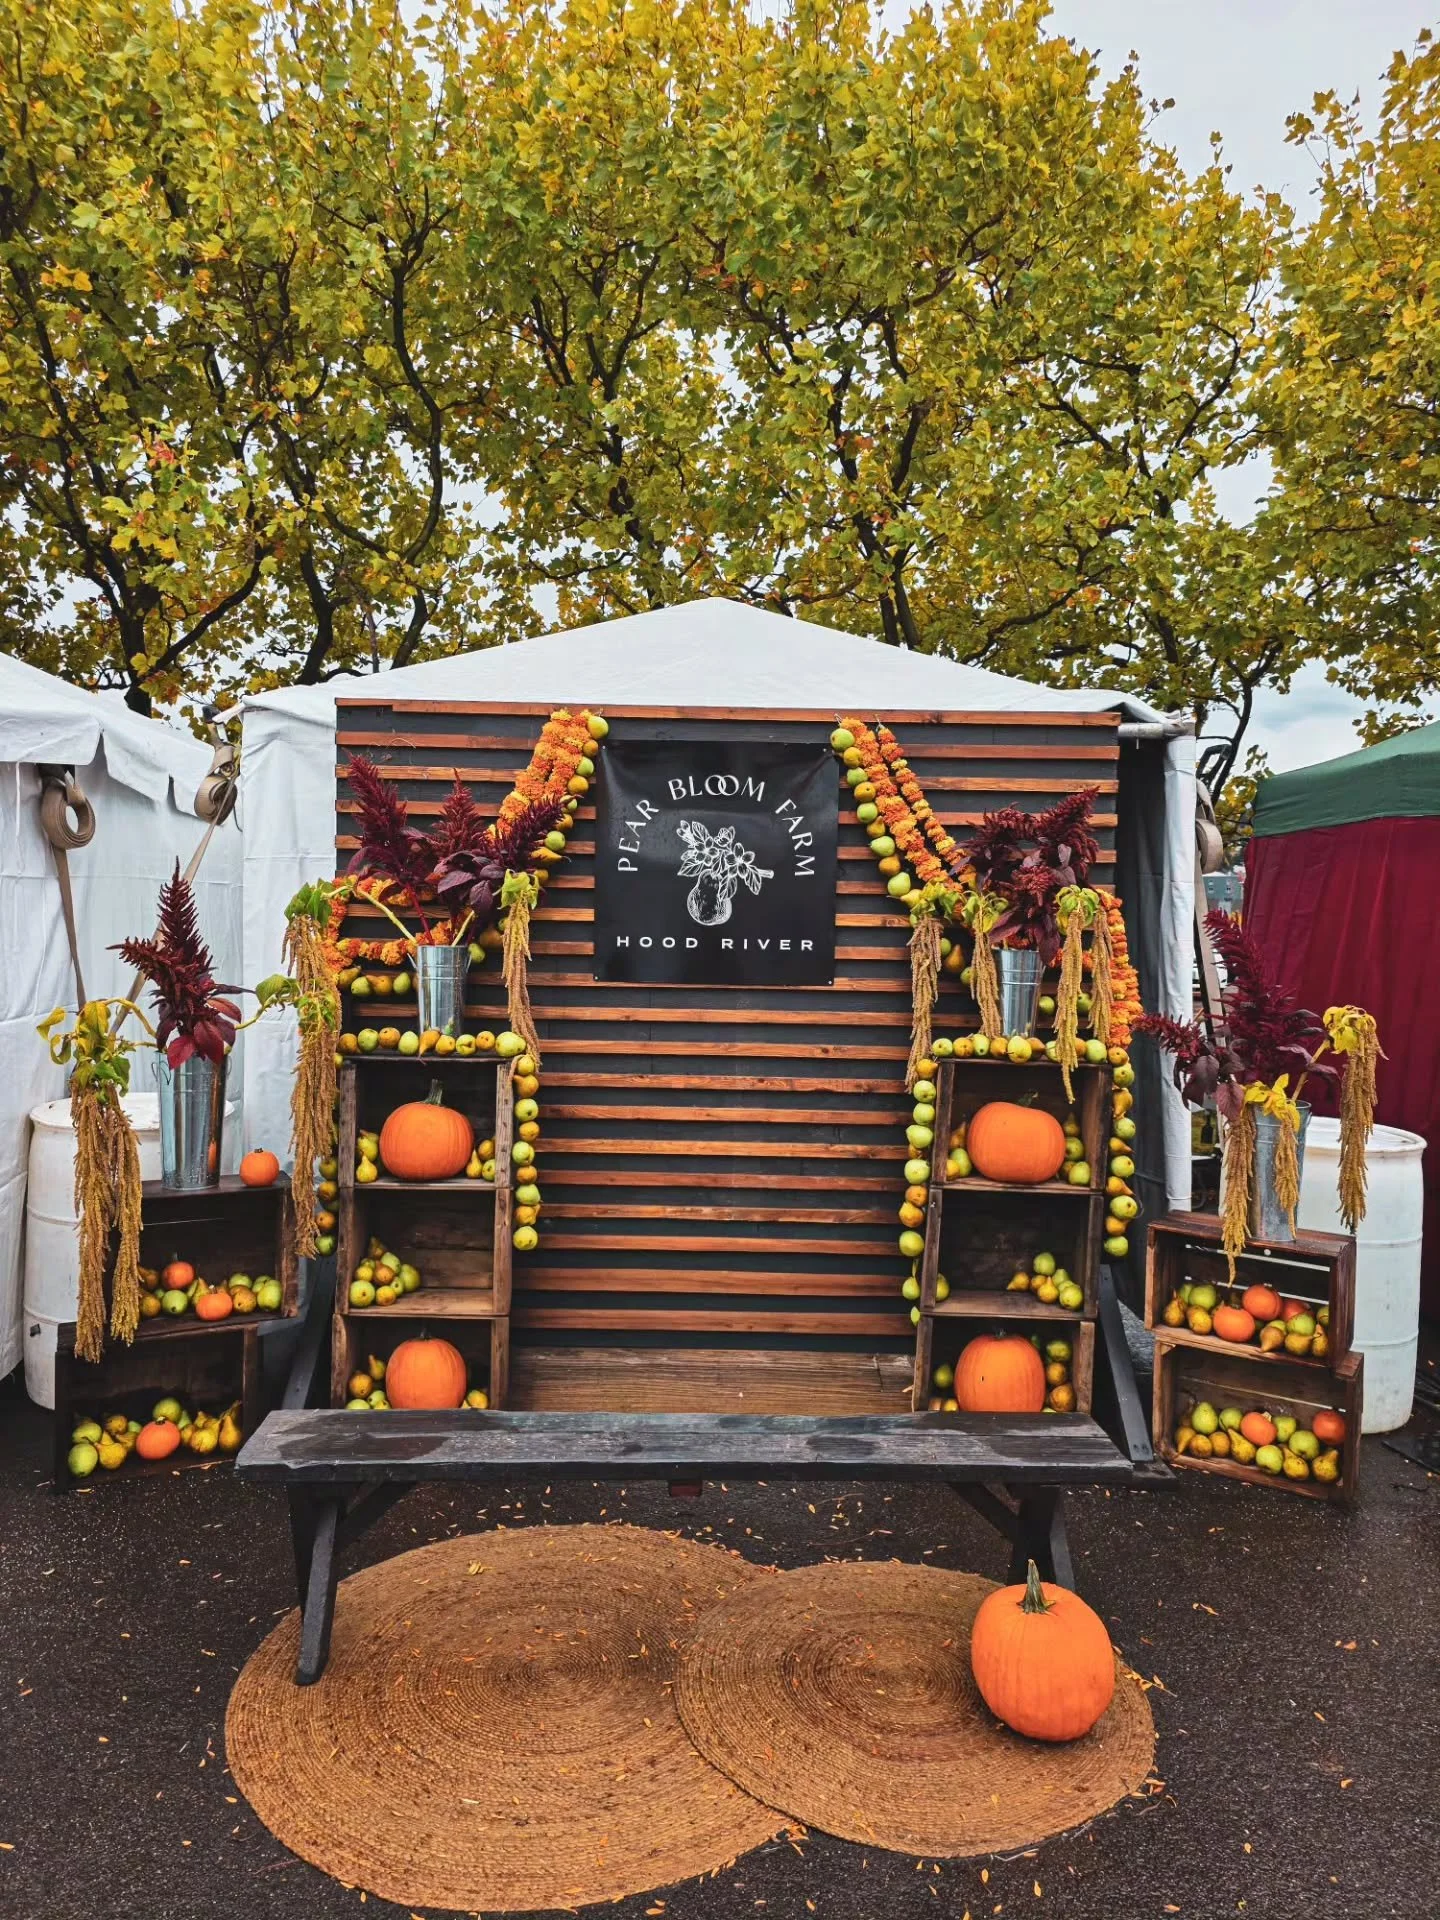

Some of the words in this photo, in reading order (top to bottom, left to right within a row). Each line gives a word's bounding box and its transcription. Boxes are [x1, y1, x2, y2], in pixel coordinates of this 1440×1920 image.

[617, 799, 660, 872] PEAR
[667, 774, 766, 802] BLOOM
[774, 798, 816, 877] FARM
[616, 935, 698, 949] HOOD
[721, 938, 814, 951] RIVER
